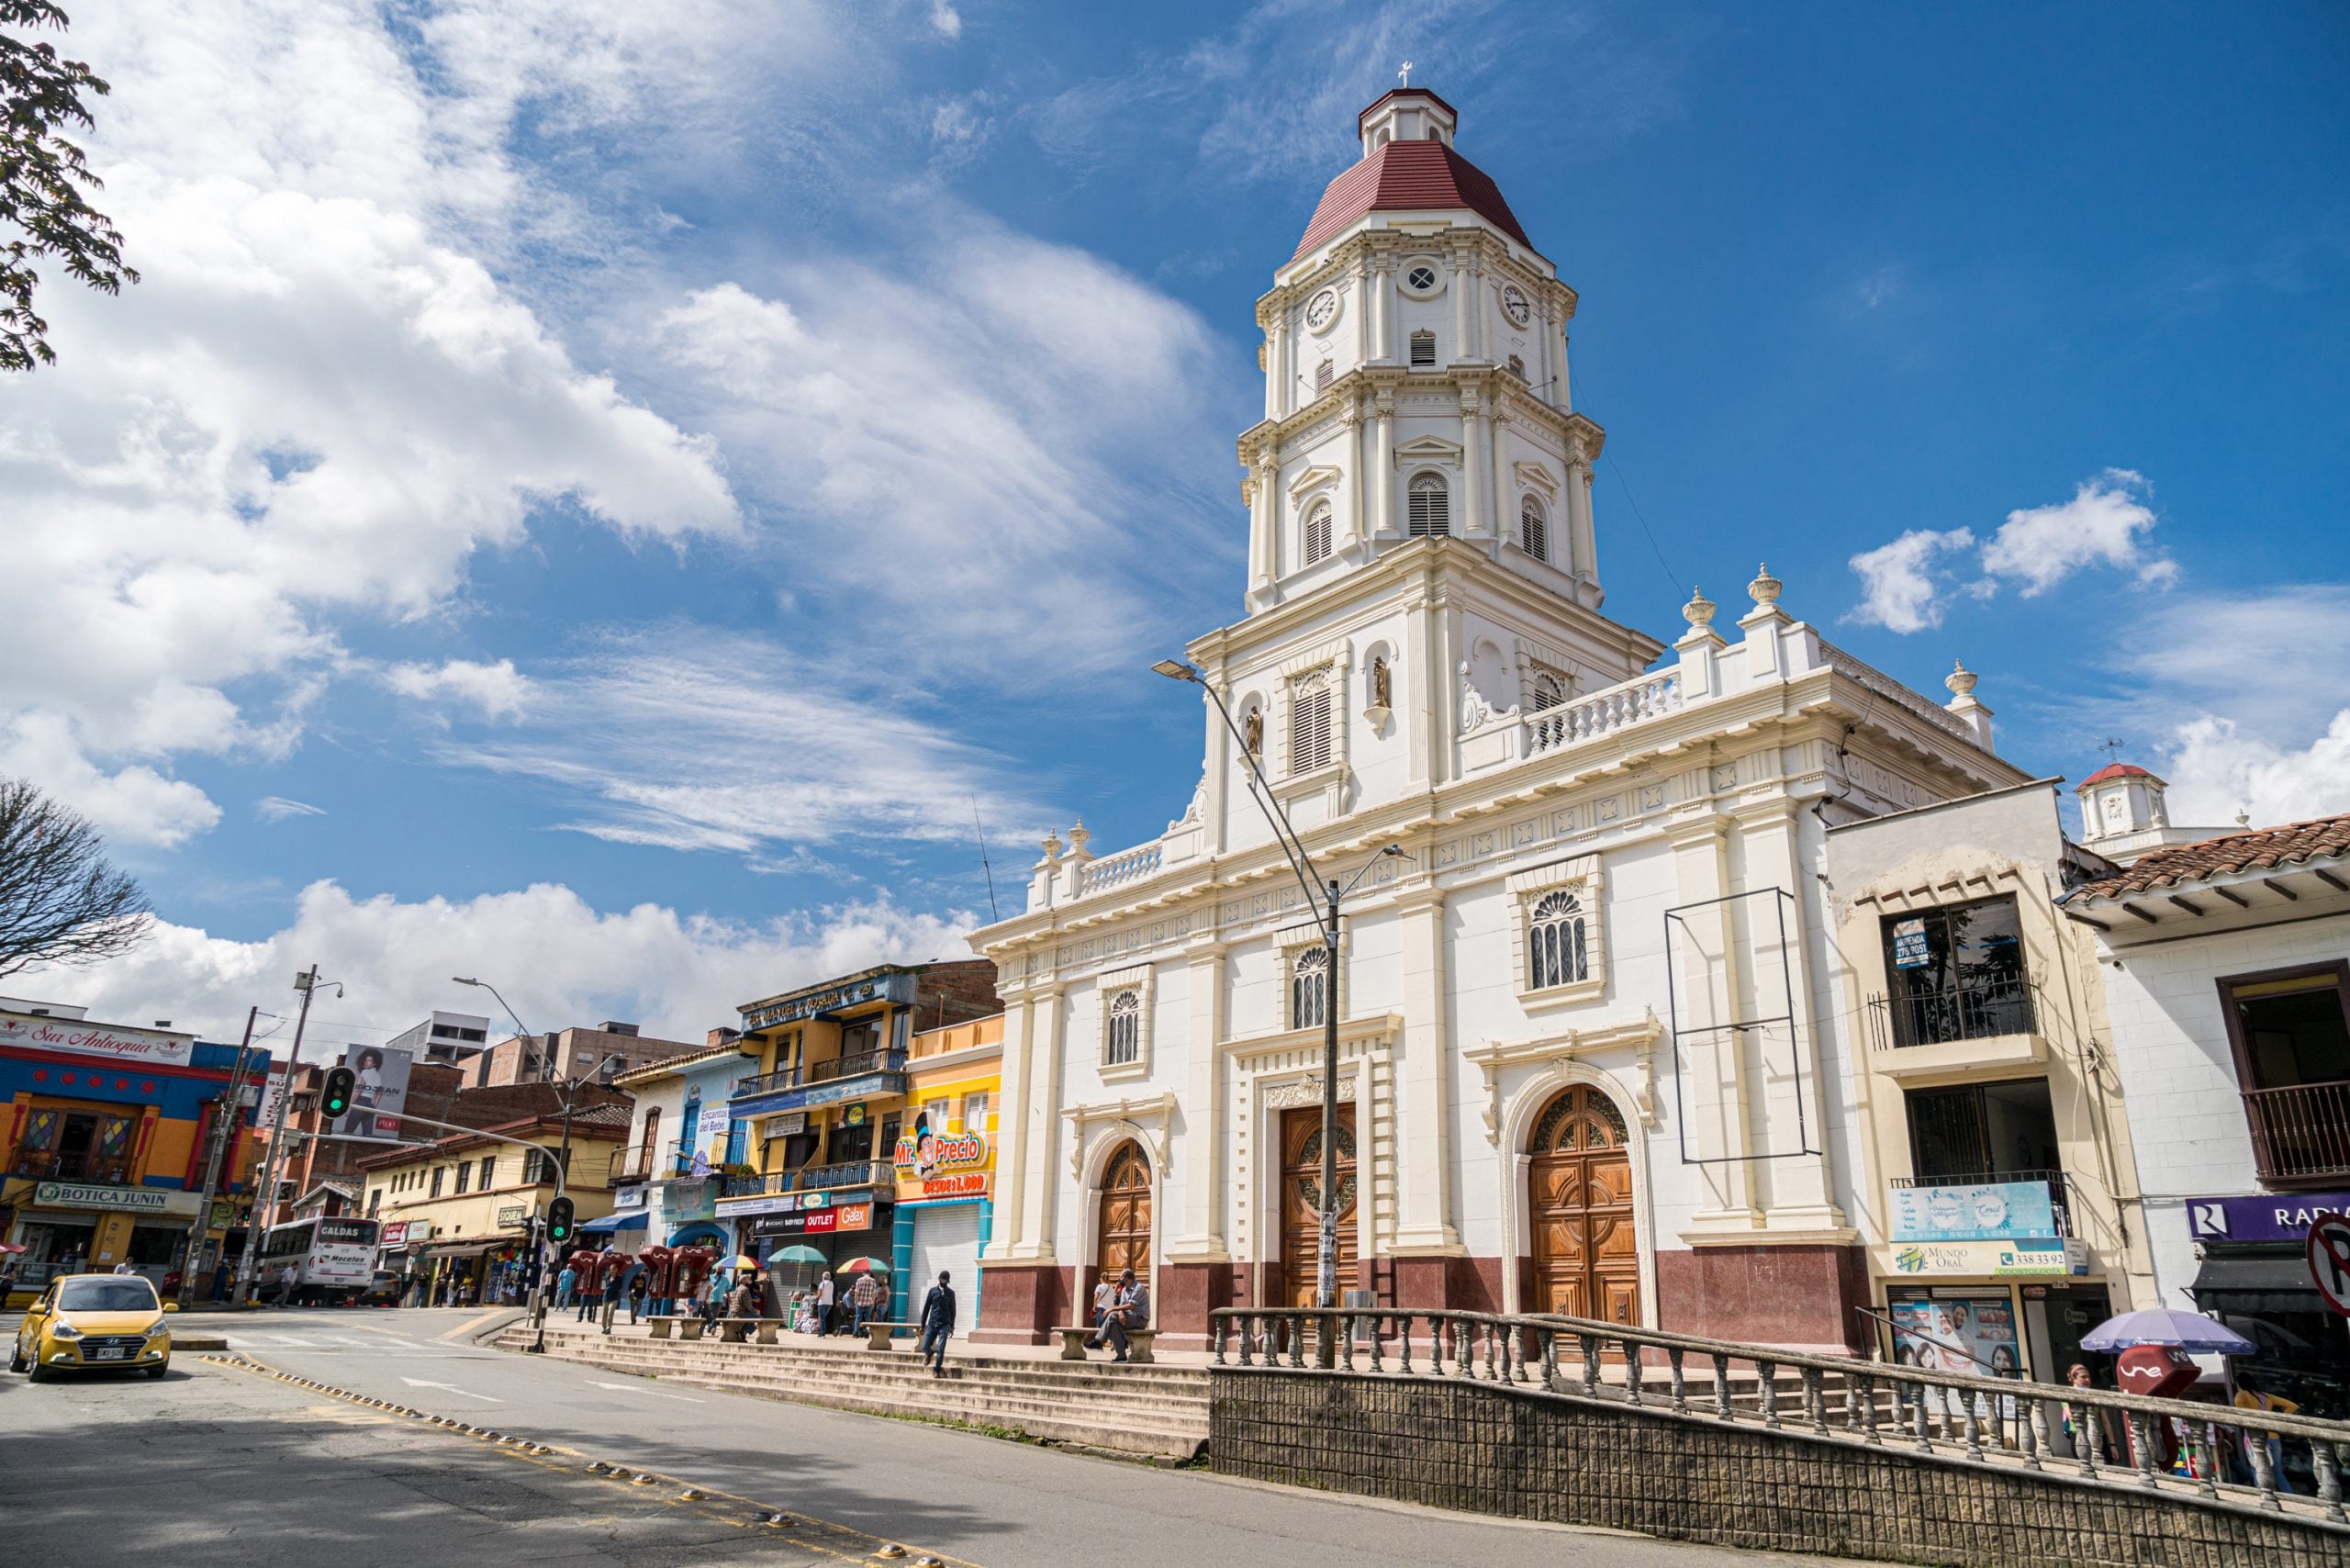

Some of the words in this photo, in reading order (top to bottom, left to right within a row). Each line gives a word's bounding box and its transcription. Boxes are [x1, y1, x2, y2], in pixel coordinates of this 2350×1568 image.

[1897, 946, 1910, 958] 278
[1910, 944, 1927, 955] 9051
[31, 1025, 62, 1041] Sur
[69, 1031, 151, 1054] Antioquia
[700, 1109, 728, 1121] Encantos
[699, 1121, 710, 1132] del
[895, 1144, 914, 1165] Mr.
[935, 1134, 978, 1160] Precio
[923, 1179, 952, 1193] DESDE
[61, 1188, 118, 1202] BOTICA
[122, 1193, 167, 1204] JUNIN
[498, 1210, 522, 1222] SIQUEM
[808, 1215, 834, 1226] OUTLET
[841, 1206, 865, 1224] Galax
[321, 1226, 359, 1237] CALDAS
[1929, 1247, 1968, 1258] MUNDO
[1936, 1257, 1964, 1268] ORAL
[2016, 1254, 2034, 1265] 338
[2037, 1254, 2049, 1265] 33
[2051, 1254, 2064, 1264] 92
[2167, 1351, 2188, 1363] une
[2120, 1365, 2164, 1378] une
